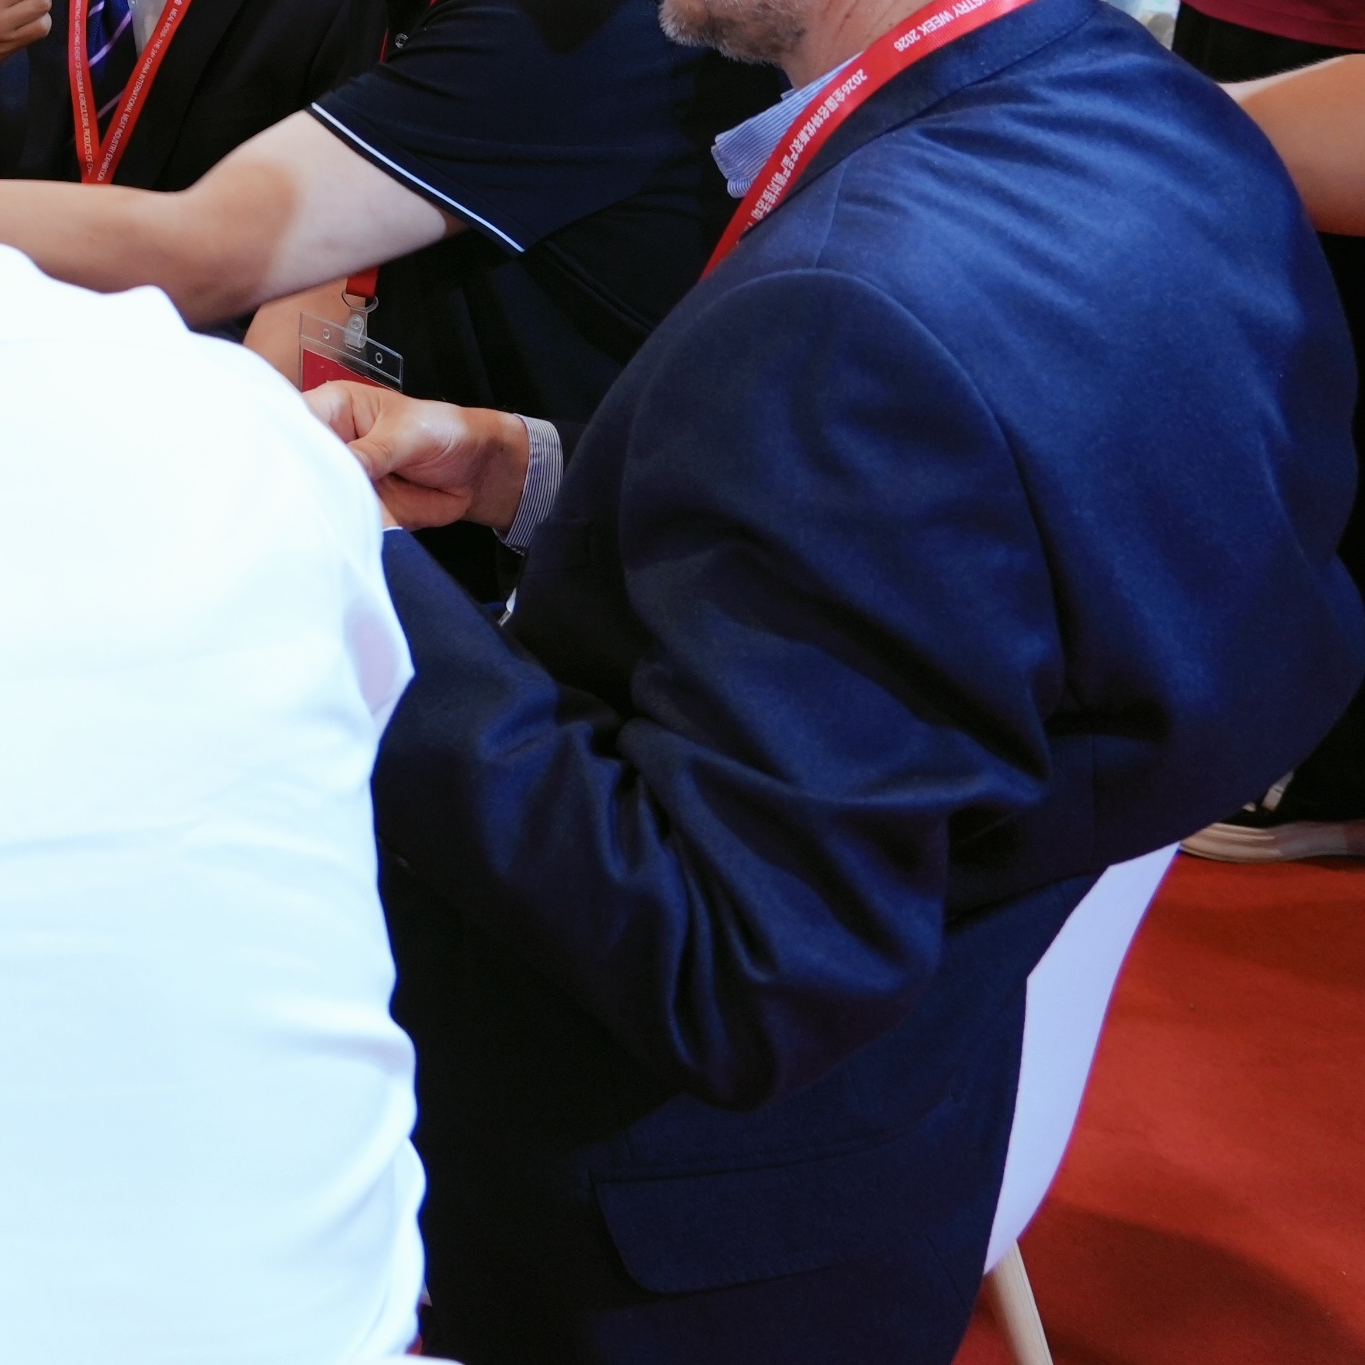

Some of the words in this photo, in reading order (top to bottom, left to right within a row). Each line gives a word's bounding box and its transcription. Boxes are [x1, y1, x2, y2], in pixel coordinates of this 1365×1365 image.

[917, 12, 954, 36] WEEK
[894, 31, 921, 53] 2026
[117, 112, 129, 128] MEAT
[107, 127, 123, 153] INDUSTRY
[96, 152, 113, 182] EXHIBITION
